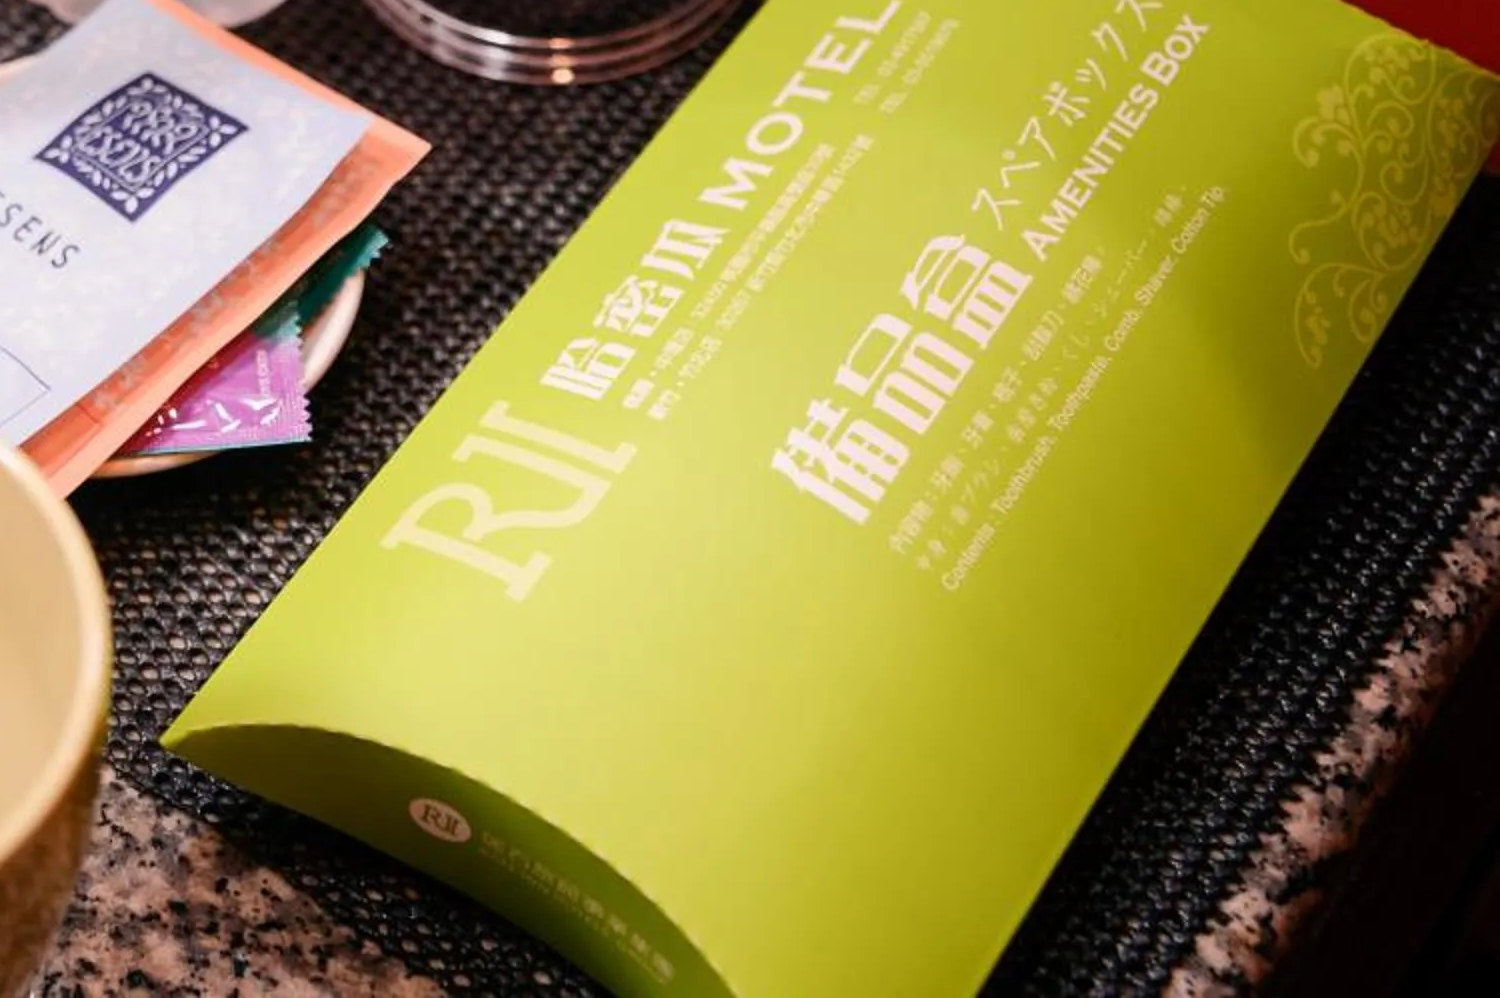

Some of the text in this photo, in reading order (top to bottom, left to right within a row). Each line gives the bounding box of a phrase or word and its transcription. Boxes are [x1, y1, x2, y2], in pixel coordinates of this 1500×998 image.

[540, 216, 732, 400] 哈密瓜
[771, 234, 1034, 526] 備品盒
